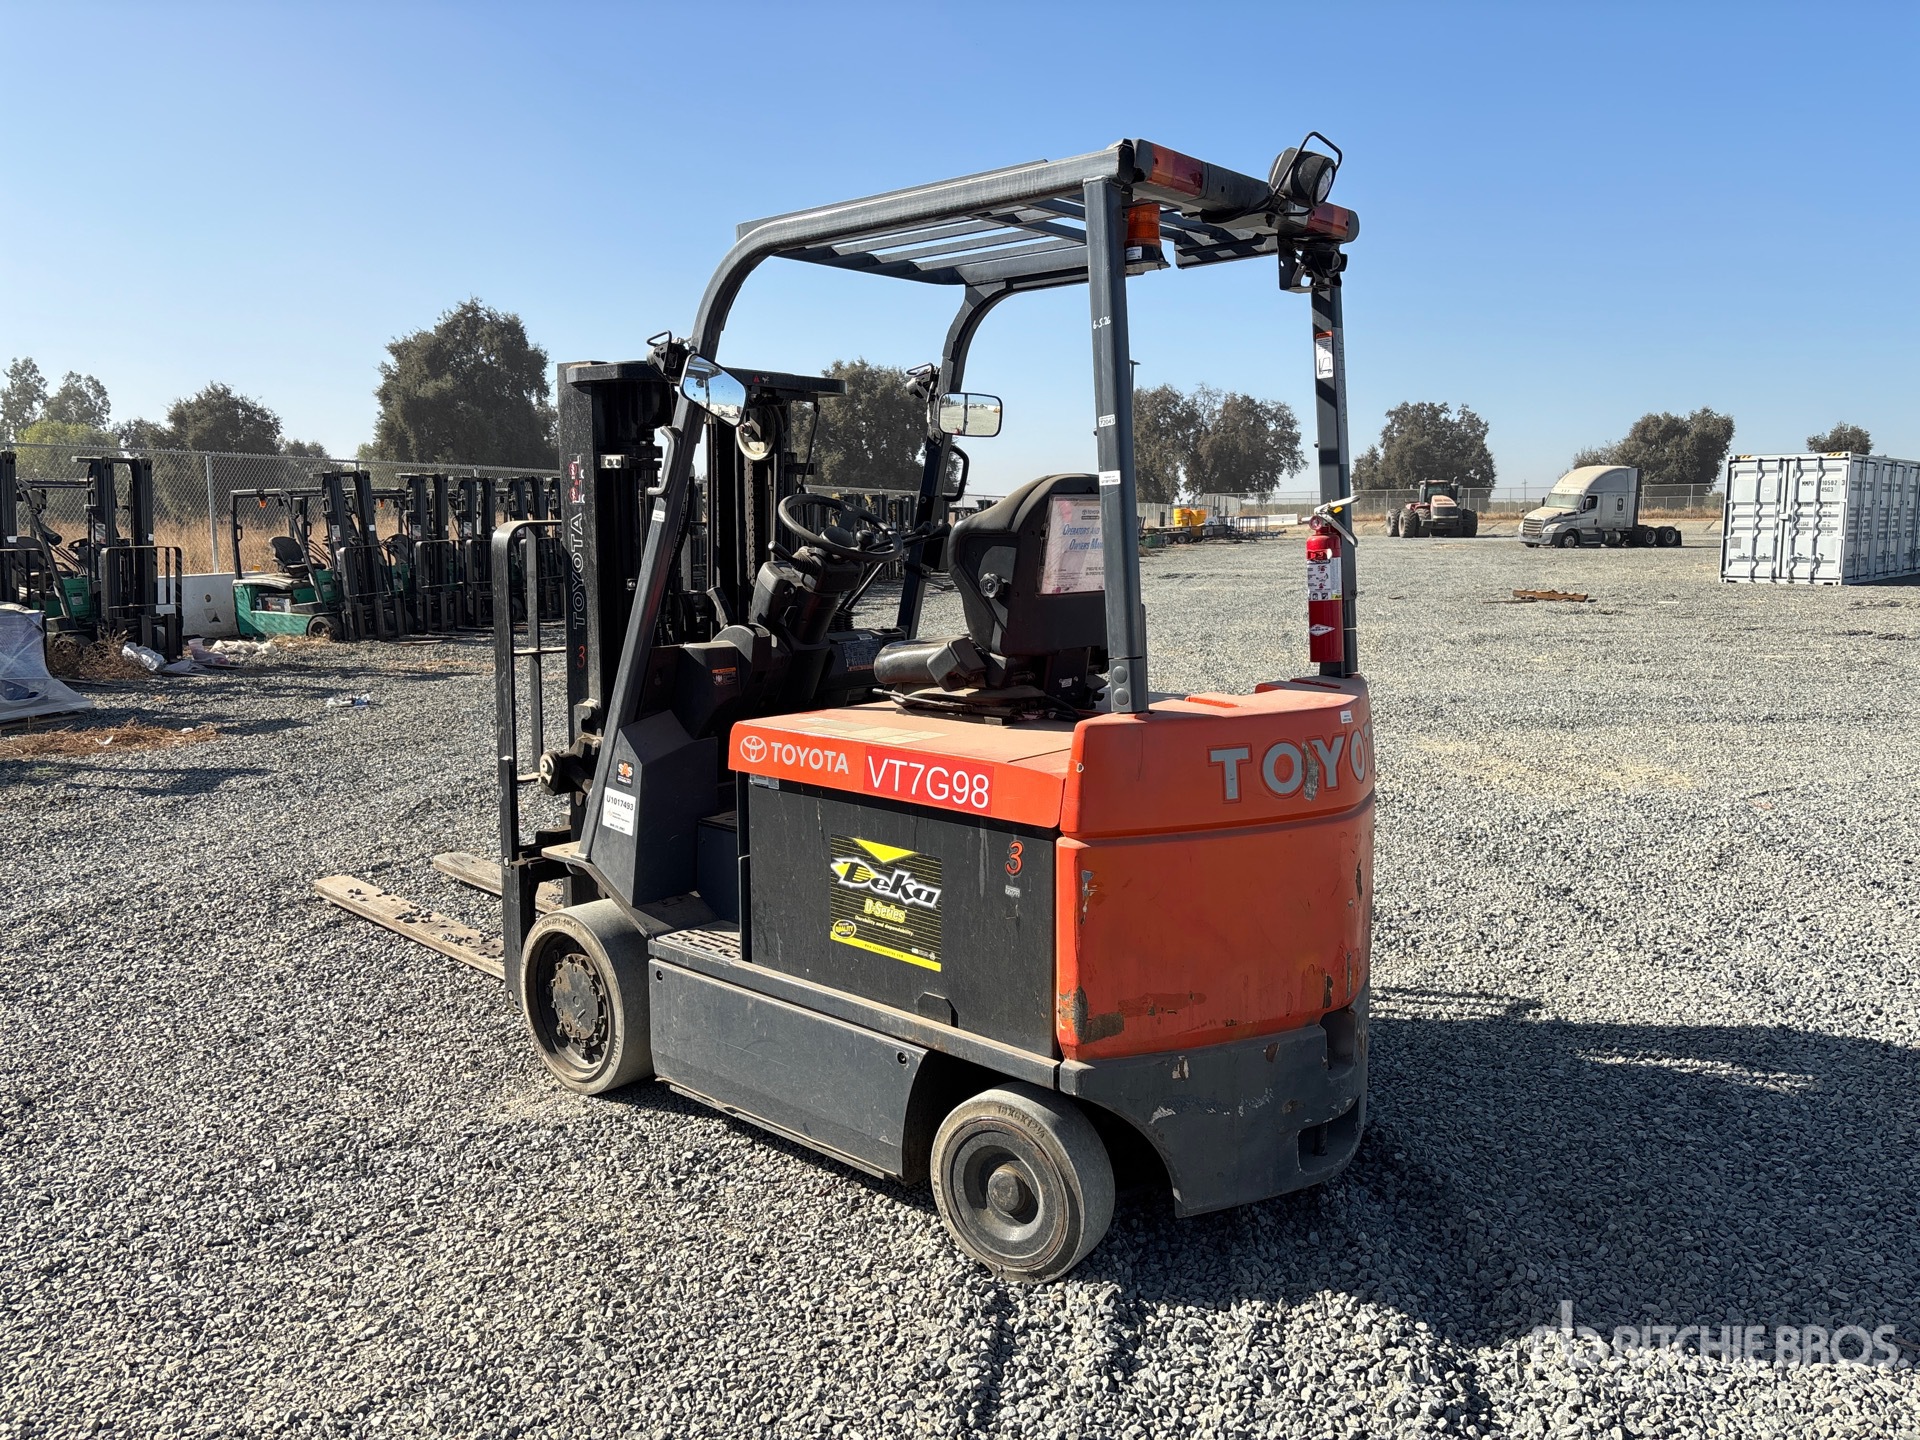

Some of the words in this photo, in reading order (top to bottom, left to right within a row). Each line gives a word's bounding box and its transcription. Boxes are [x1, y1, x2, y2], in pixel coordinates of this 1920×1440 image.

[571, 512, 586, 629] TOYOTA
[577, 646, 585, 668] 3
[771, 742, 849, 774] TOYOTA
[867, 755, 990, 809] VT7G98
[606, 795, 634, 811] U1017493
[1005, 841, 1023, 876] 3
[831, 858, 941, 908] Deka
[864, 898, 905, 923] D-Series
